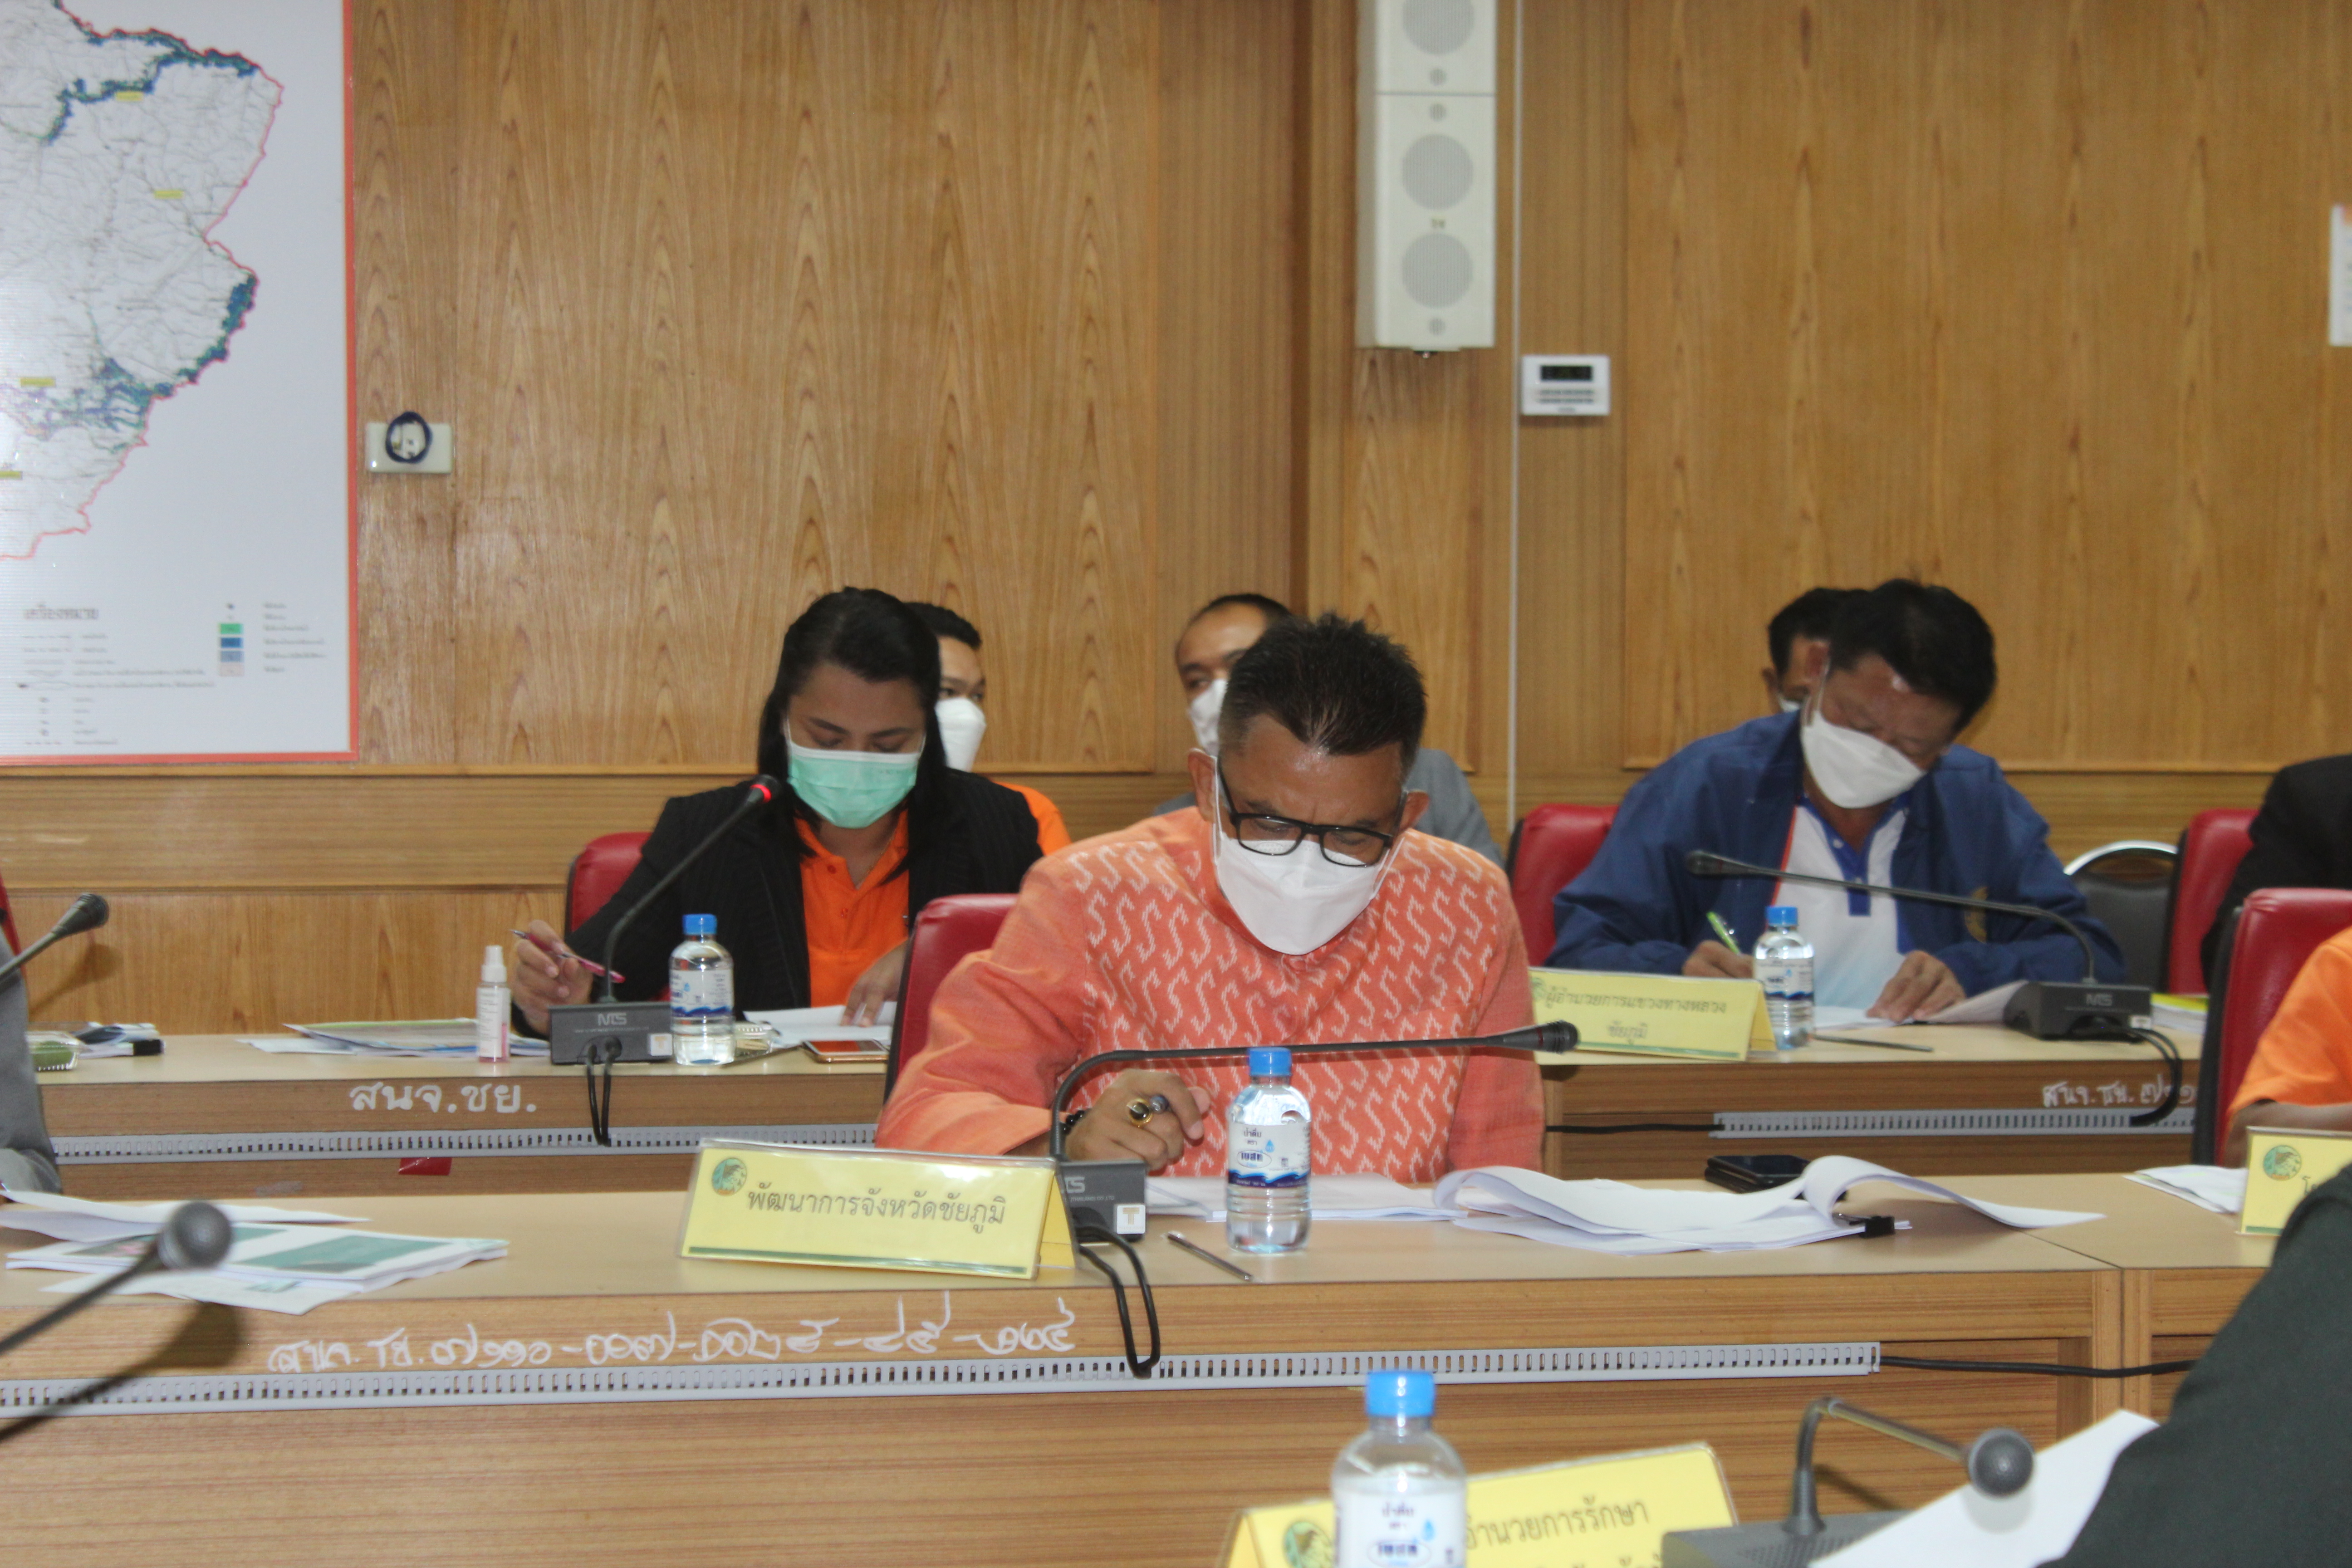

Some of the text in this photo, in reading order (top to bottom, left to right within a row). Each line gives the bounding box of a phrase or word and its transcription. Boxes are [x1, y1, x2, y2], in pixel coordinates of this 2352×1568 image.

[748, 1181, 1006, 1234] พัฒนาการจังหวัดชัยภูมิ
